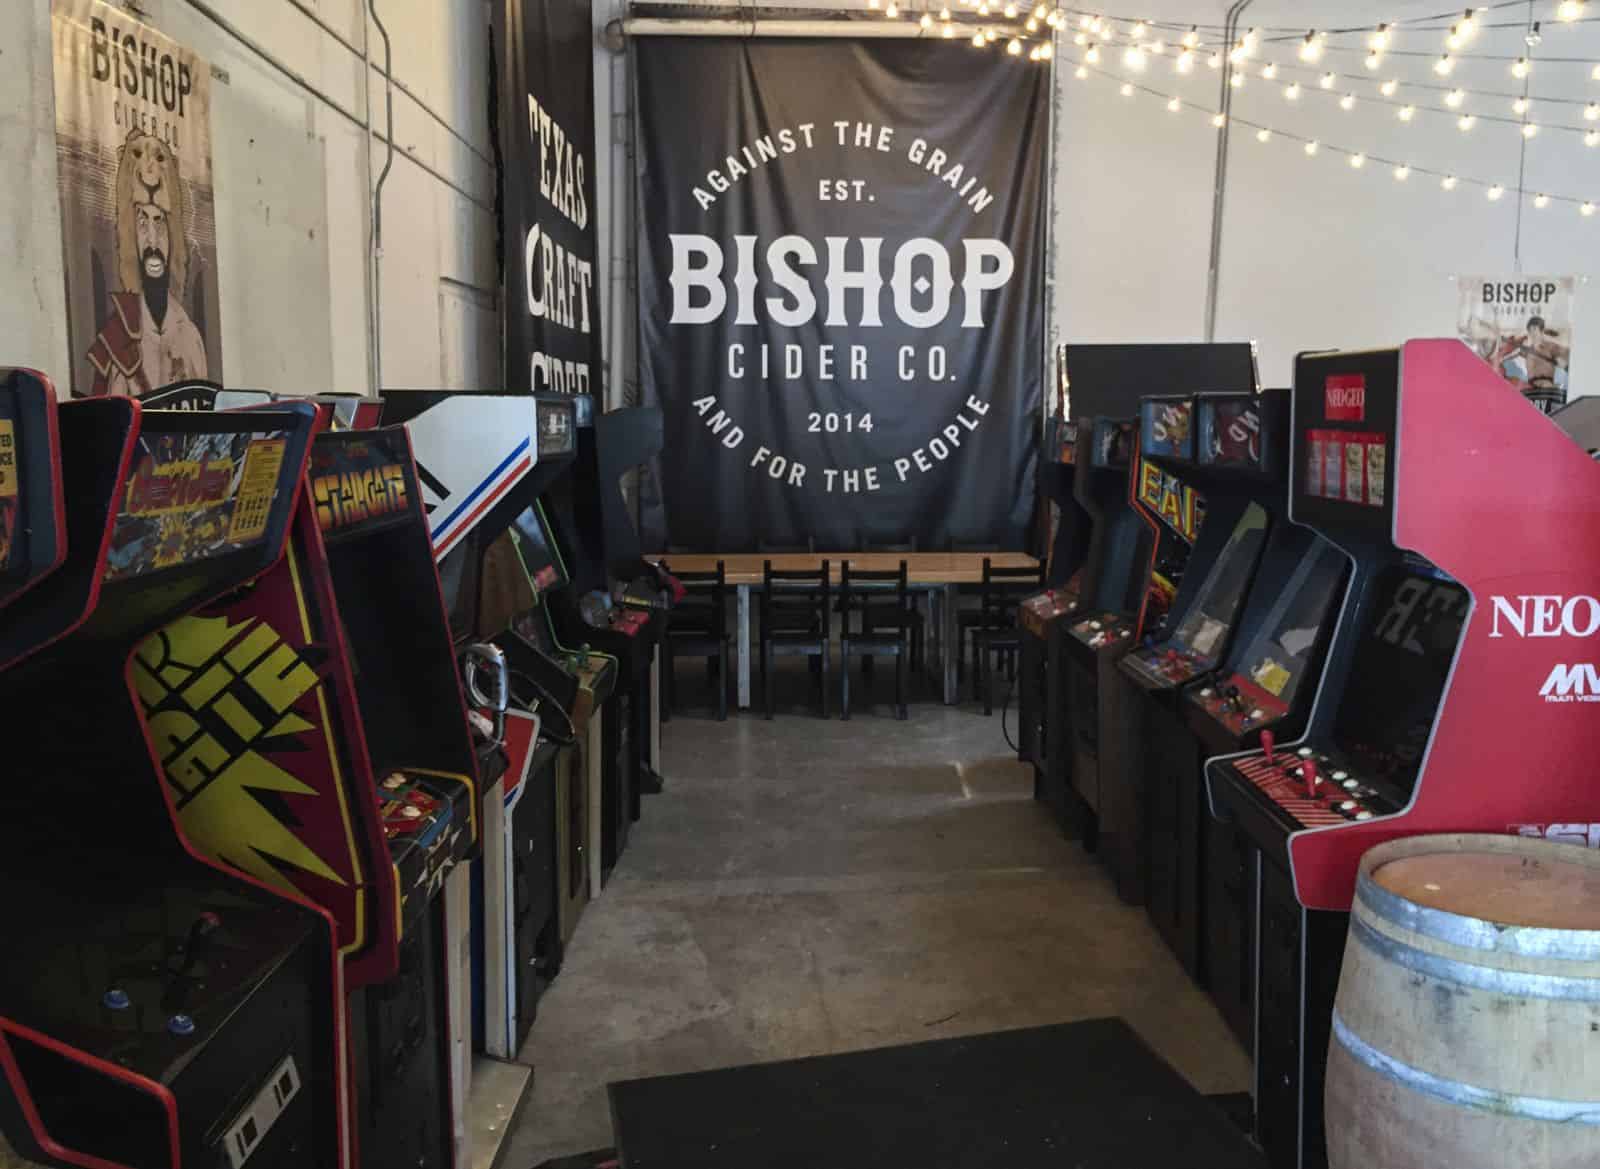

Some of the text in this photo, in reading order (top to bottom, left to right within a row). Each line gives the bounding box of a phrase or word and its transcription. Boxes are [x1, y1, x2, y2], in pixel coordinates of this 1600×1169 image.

[91, 16, 191, 117] BISHOP
[527, 93, 587, 230] TEXAS
[692, 121, 993, 214] AGAINST THE GRAIN
[819, 180, 875, 201] EST.
[526, 223, 592, 333] CRAFT
[668, 233, 1015, 328] BISHOP
[1482, 283, 1556, 303] BISHOP
[728, 343, 957, 381] CIDER CO.
[692, 394, 990, 493] AND FOR THE PEOPLE
[807, 412, 874, 433] 2014
[314, 464, 408, 529] STARGATE
[1488, 594, 1600, 638] NEO
